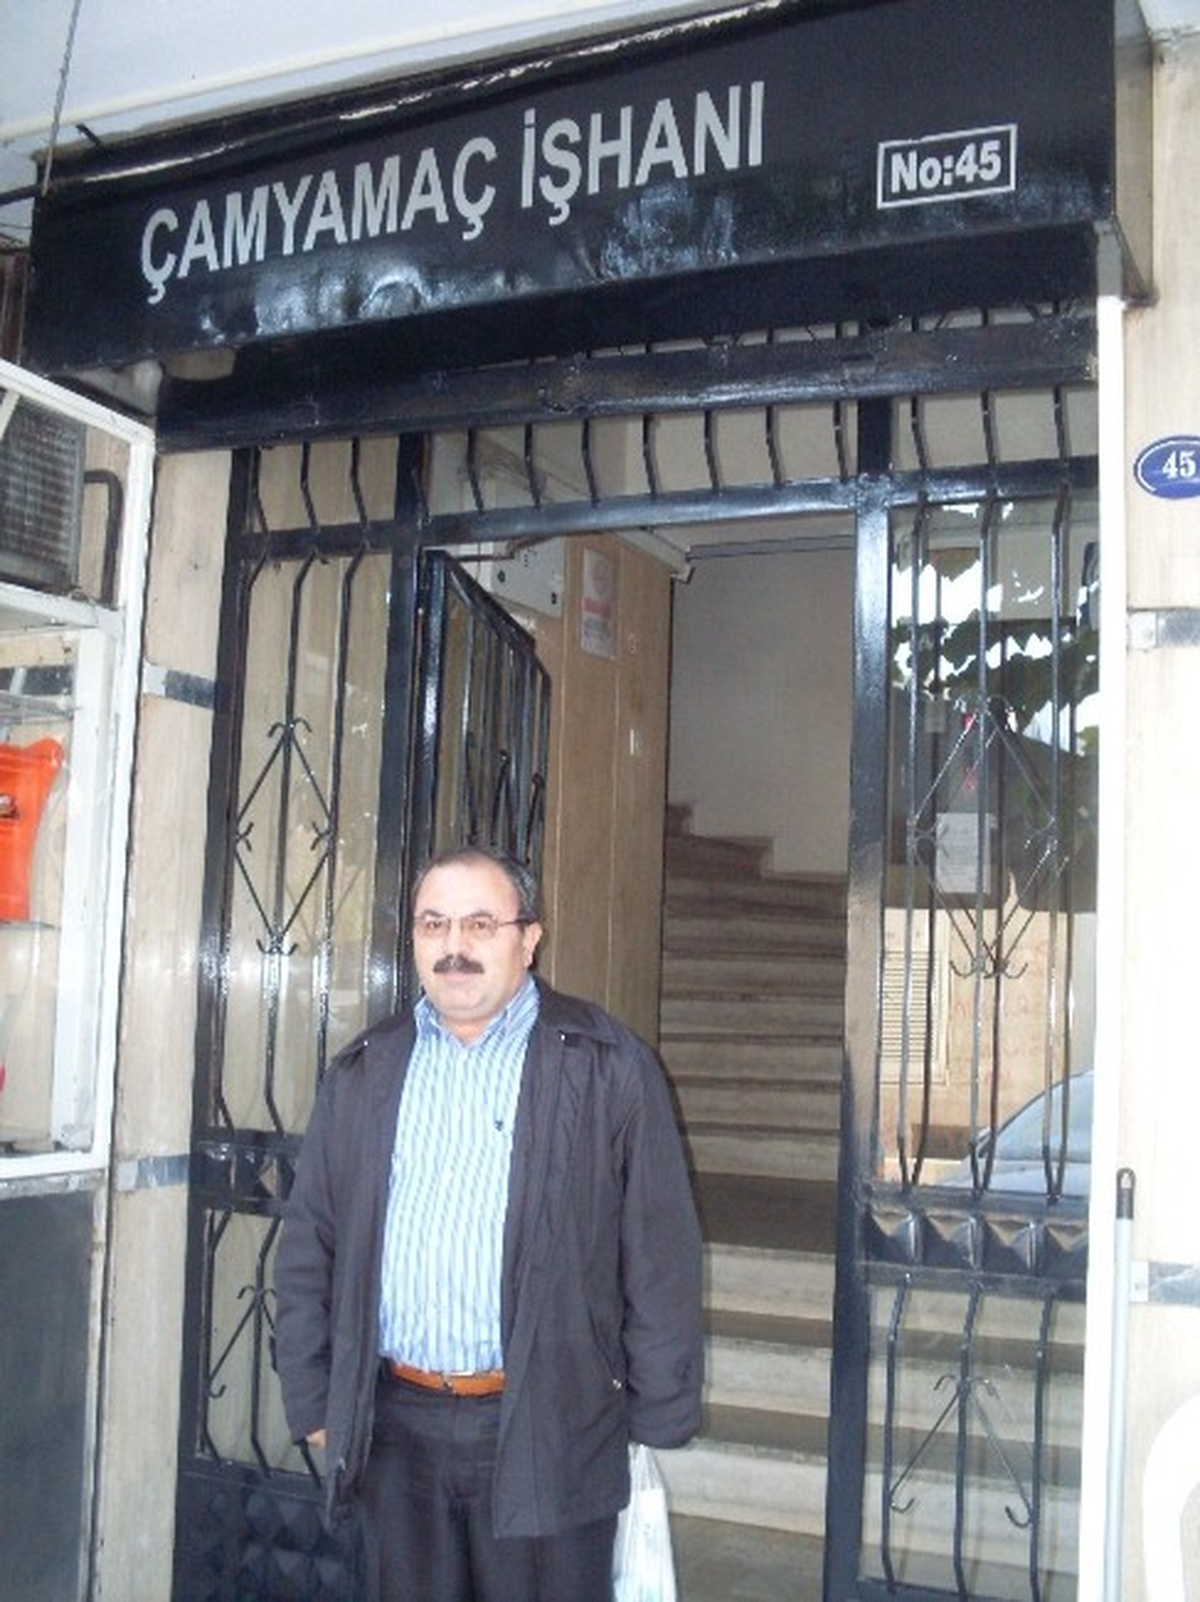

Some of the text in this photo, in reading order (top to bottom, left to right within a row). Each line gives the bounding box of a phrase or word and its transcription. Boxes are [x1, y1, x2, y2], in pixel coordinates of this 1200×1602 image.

[140, 81, 765, 304] ÇAMYAMAÇ İŞHANI
[891, 140, 1002, 193] No:45
[1162, 451, 1196, 479] 45
